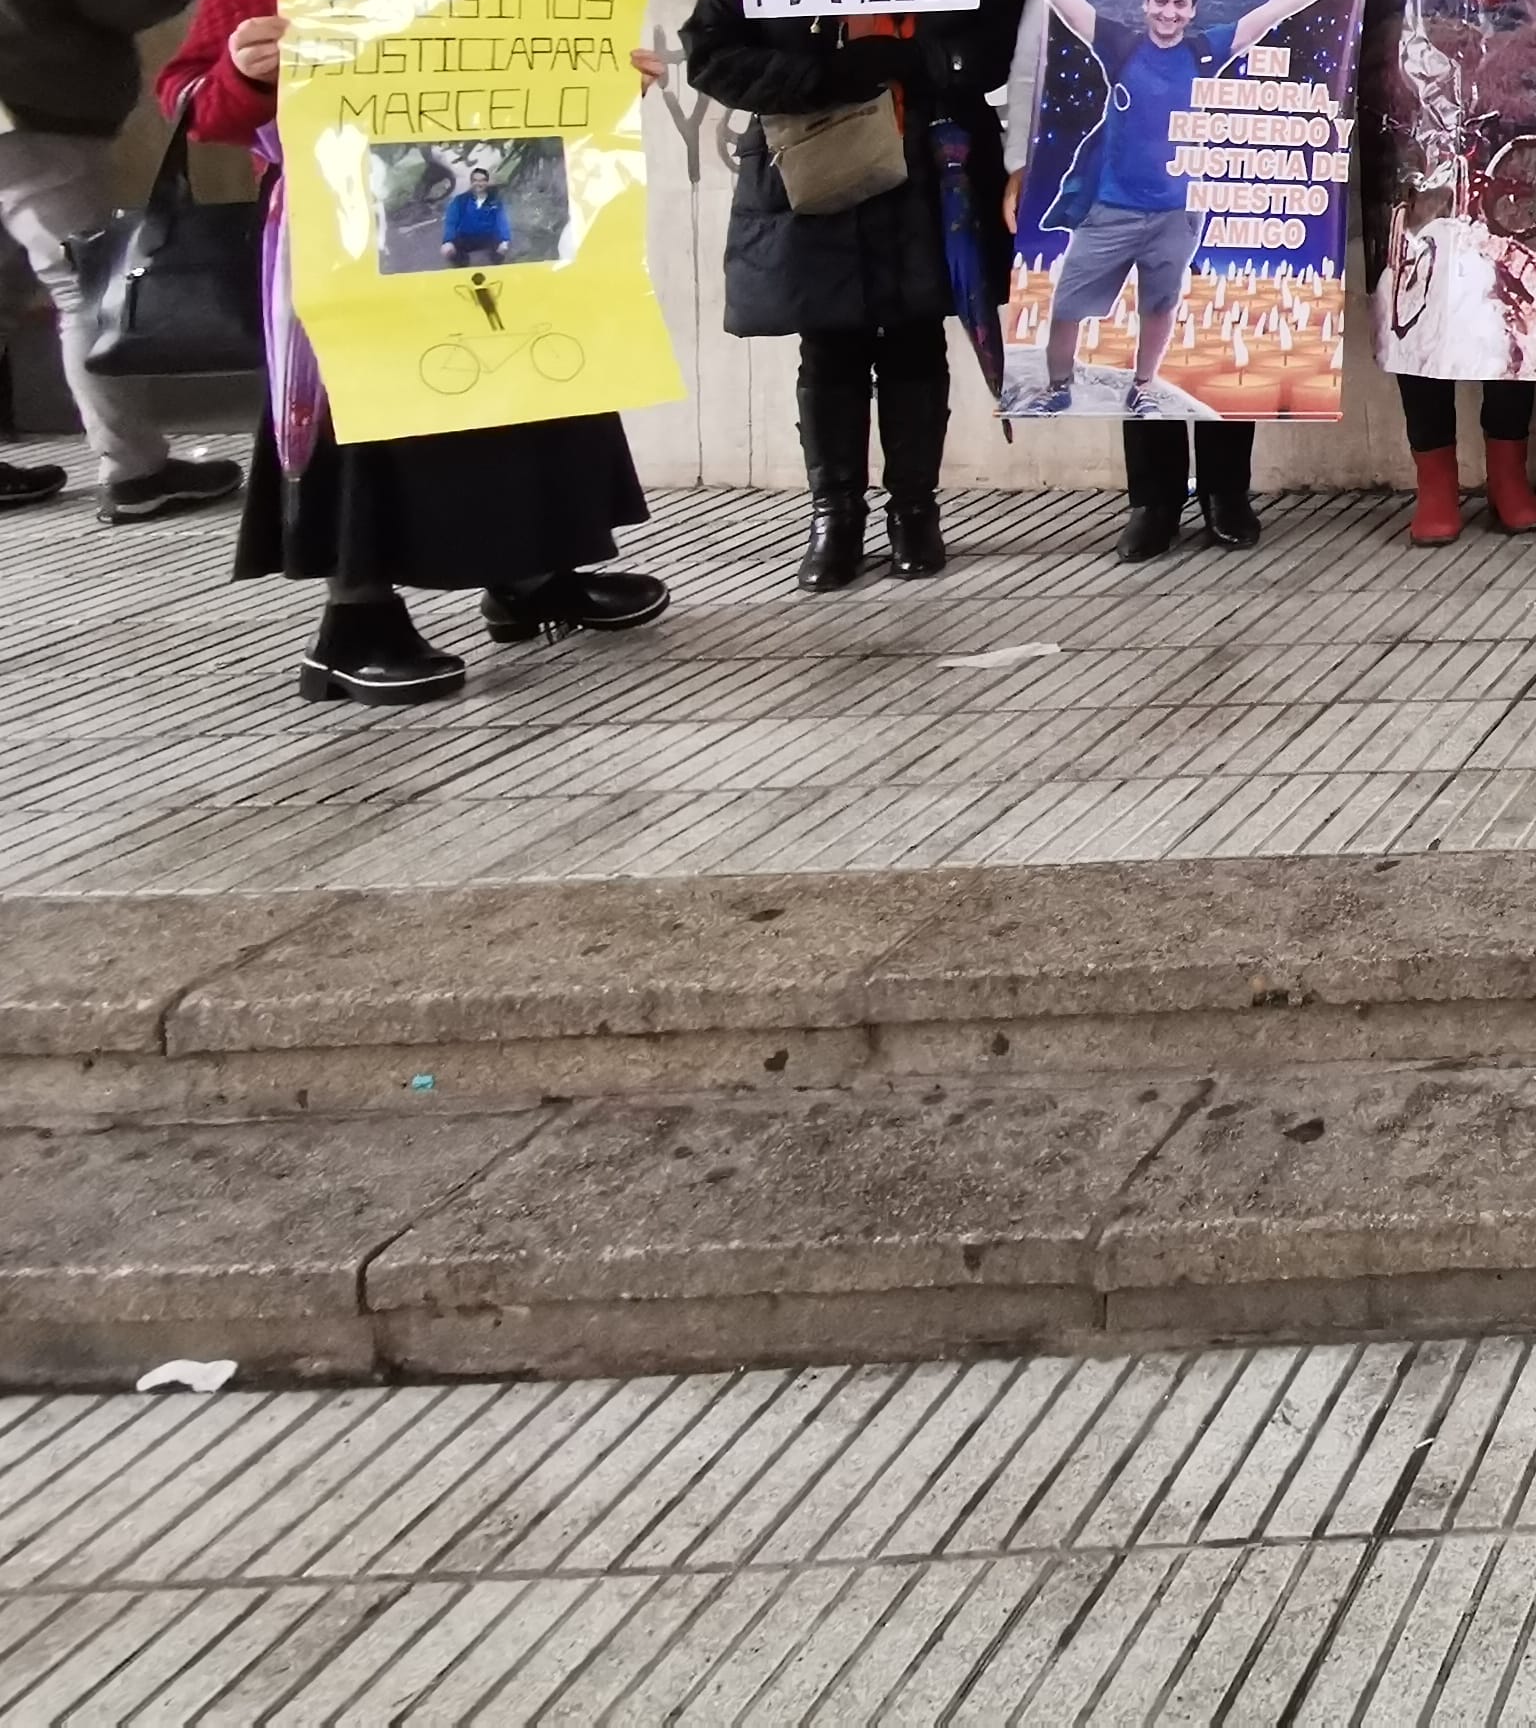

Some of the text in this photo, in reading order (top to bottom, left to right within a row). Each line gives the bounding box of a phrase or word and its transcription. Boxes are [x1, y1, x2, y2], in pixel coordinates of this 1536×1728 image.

[1248, 46, 1290, 76] EN
[337, 86, 590, 135] MARCELO
[1192, 79, 1339, 119] MEMORIA,
[1169, 112, 1354, 148] RECUERDO Y
[1167, 146, 1349, 182] JUSTICIA DE
[1187, 182, 1328, 215] NUESTRO
[1203, 218, 1305, 249] AMIGO
